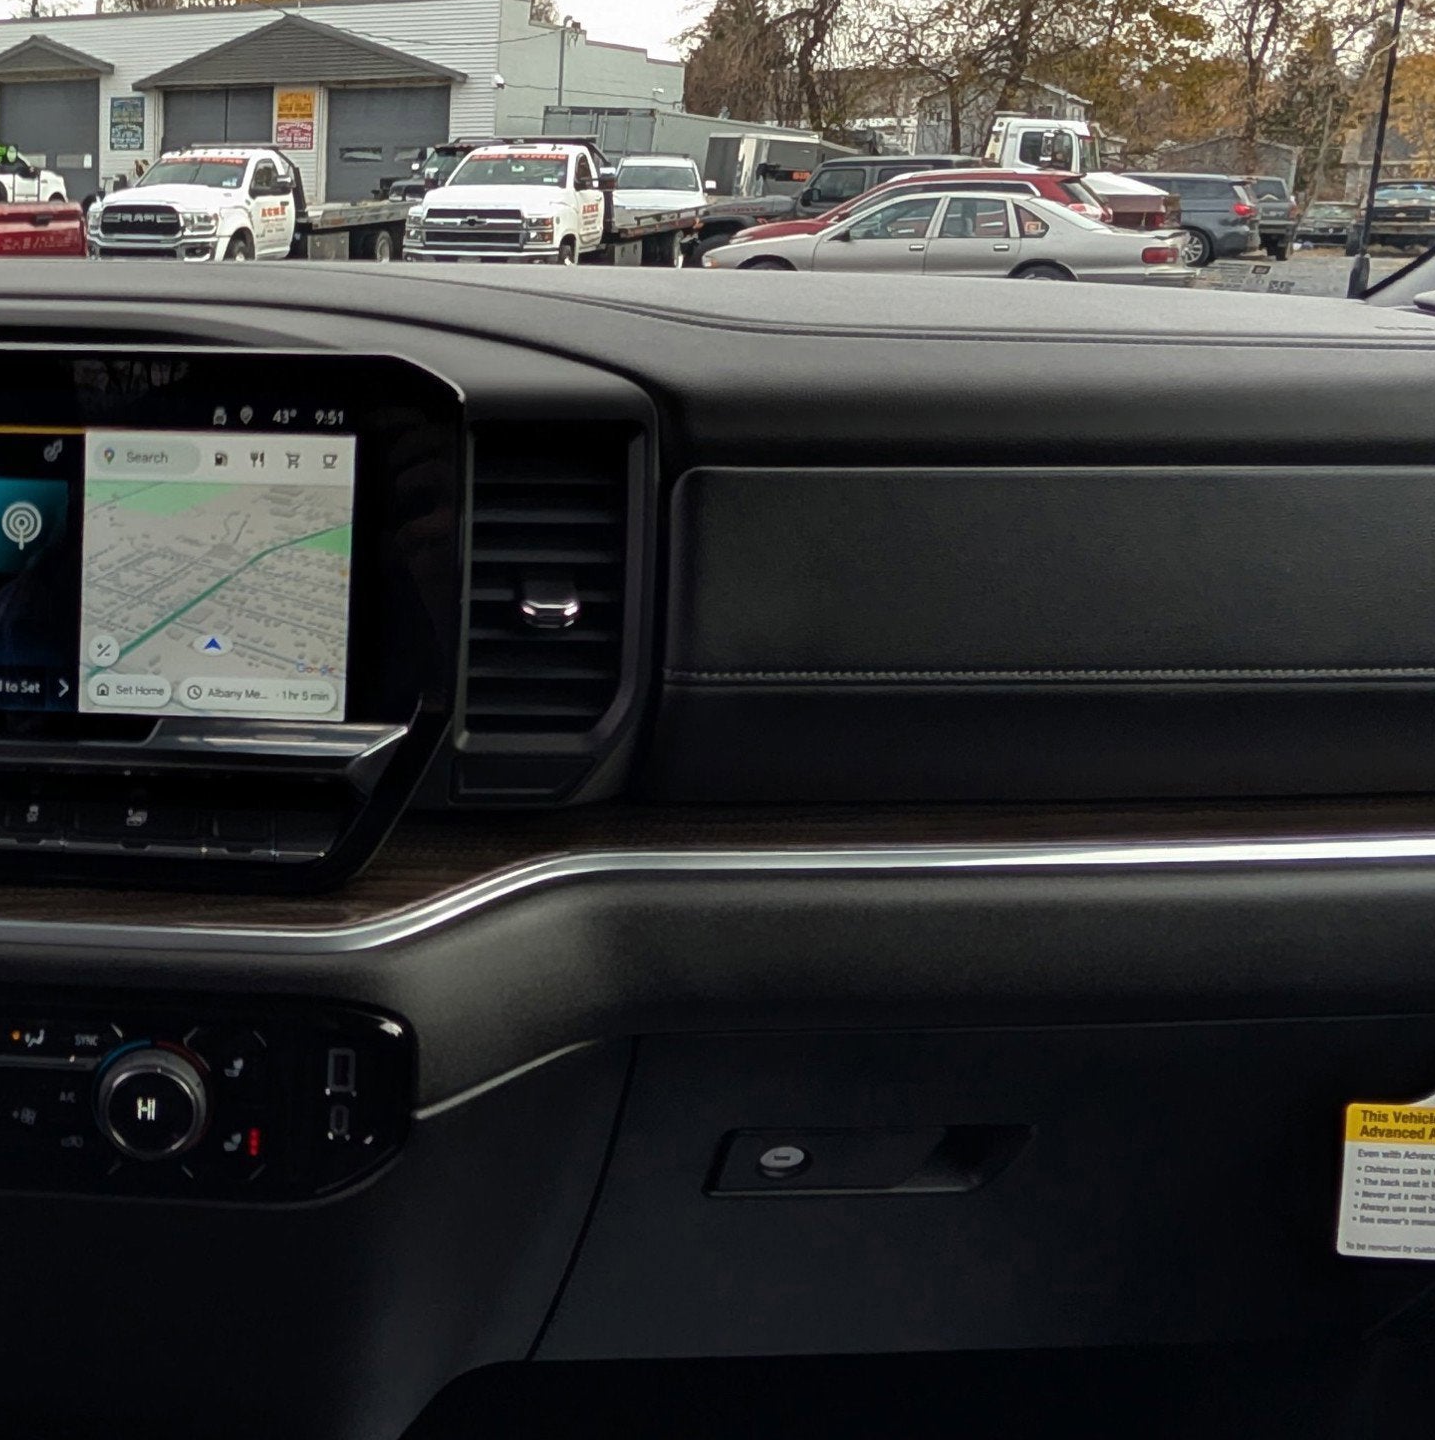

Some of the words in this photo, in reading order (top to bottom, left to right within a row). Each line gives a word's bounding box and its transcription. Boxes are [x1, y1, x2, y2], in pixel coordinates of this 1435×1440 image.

[121, 212, 157, 223] RAM
[272, 408, 298, 425] 43°
[314, 409, 345, 426] 9:51
[125, 451, 169, 465] Search
[5, 680, 18, 693] to
[20, 679, 41, 694] Set
[115, 684, 133, 697] Set
[135, 685, 165, 697] Home
[207, 686, 243, 702] Albany
[310, 691, 330, 703] min
[74, 1033, 99, 1048] SYNC
[136, 1097, 157, 1123] HI
[1361, 1110, 1388, 1122] This
[1360, 1125, 1425, 1139] Advanced
[1358, 1149, 1379, 1157] Even
